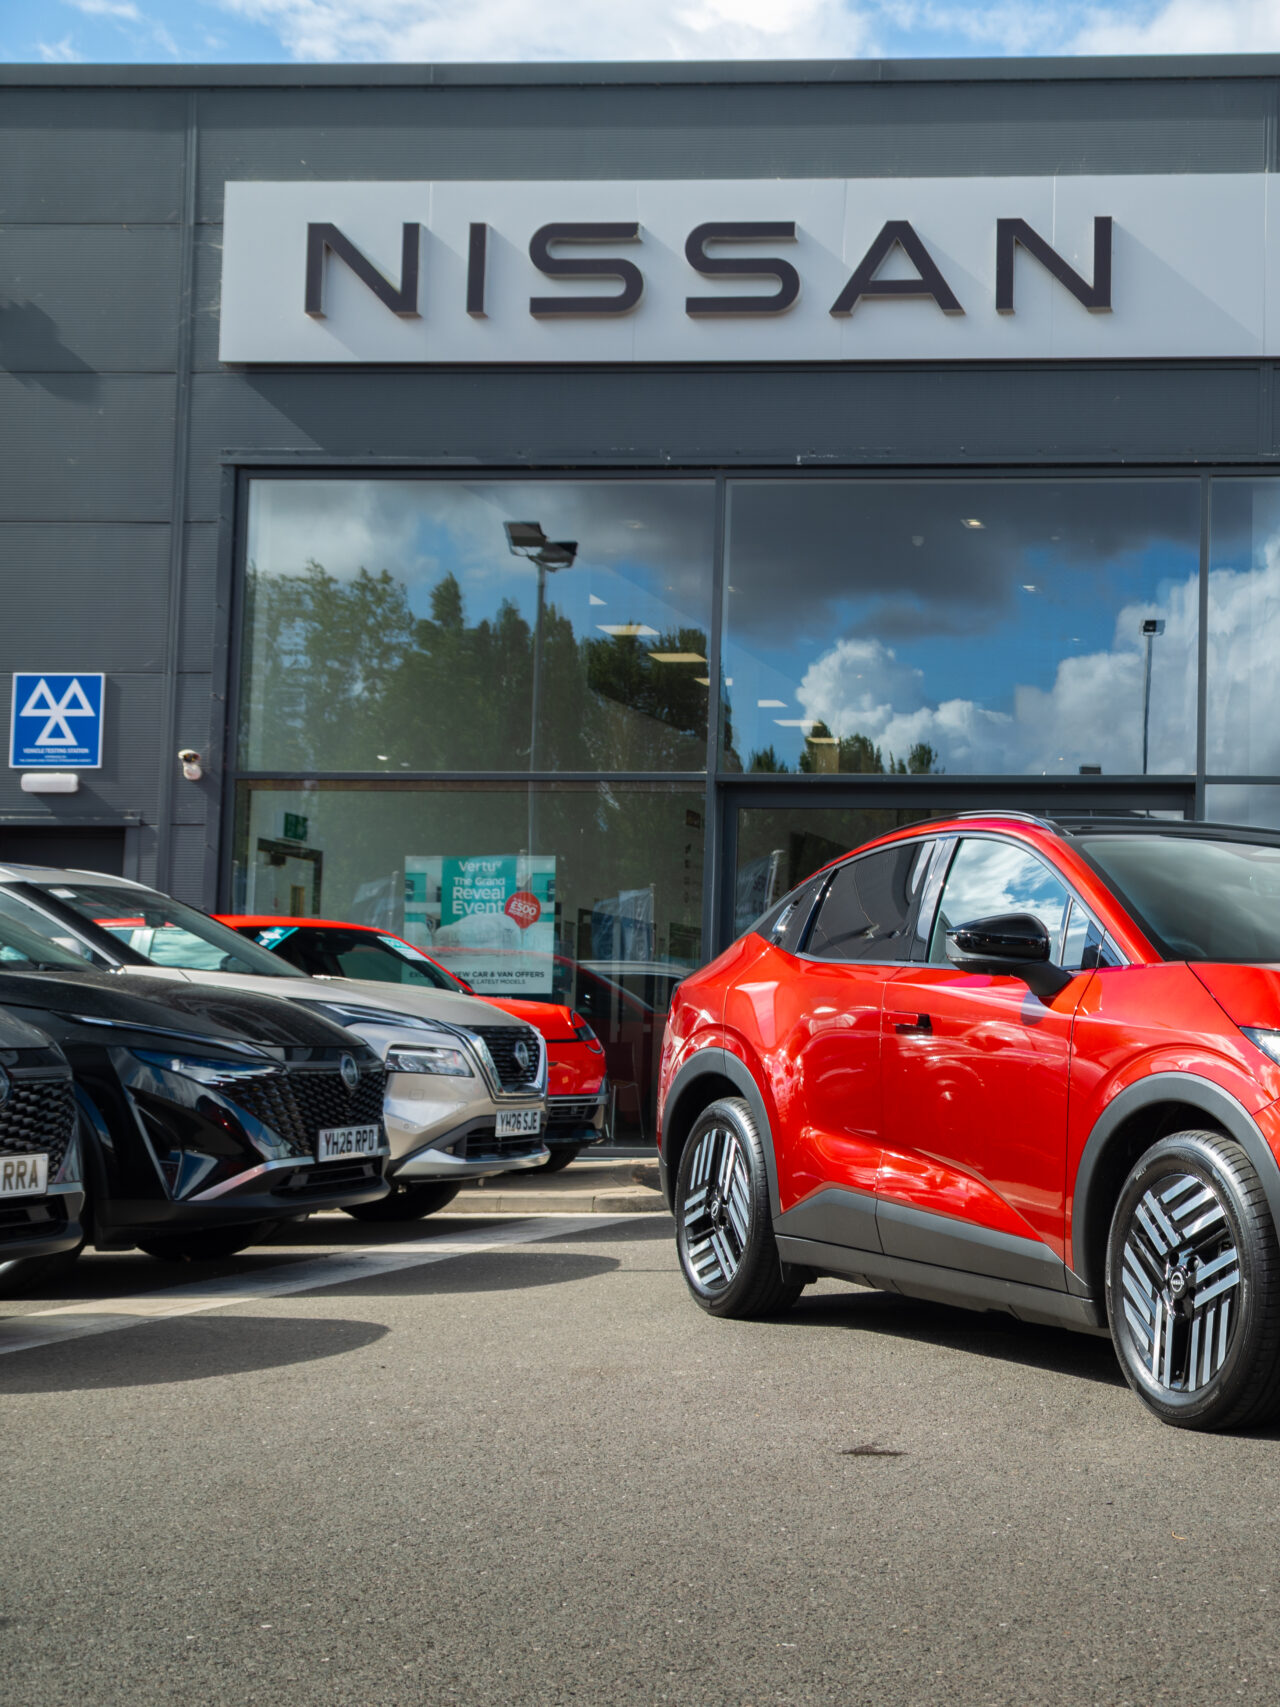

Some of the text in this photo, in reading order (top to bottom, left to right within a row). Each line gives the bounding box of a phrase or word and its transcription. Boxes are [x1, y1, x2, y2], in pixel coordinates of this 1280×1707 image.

[304, 216, 1113, 320] NISSAN
[458, 861, 496, 872] Vertu
[454, 876, 506, 885] The Grand
[452, 886, 505, 899] Reveal
[452, 900, 504, 914] Event
[510, 901, 537, 916] £500
[500, 1112, 537, 1132] YH26 SJE
[325, 1131, 353, 1155] YH26
[2, 1159, 38, 1191] RRA
